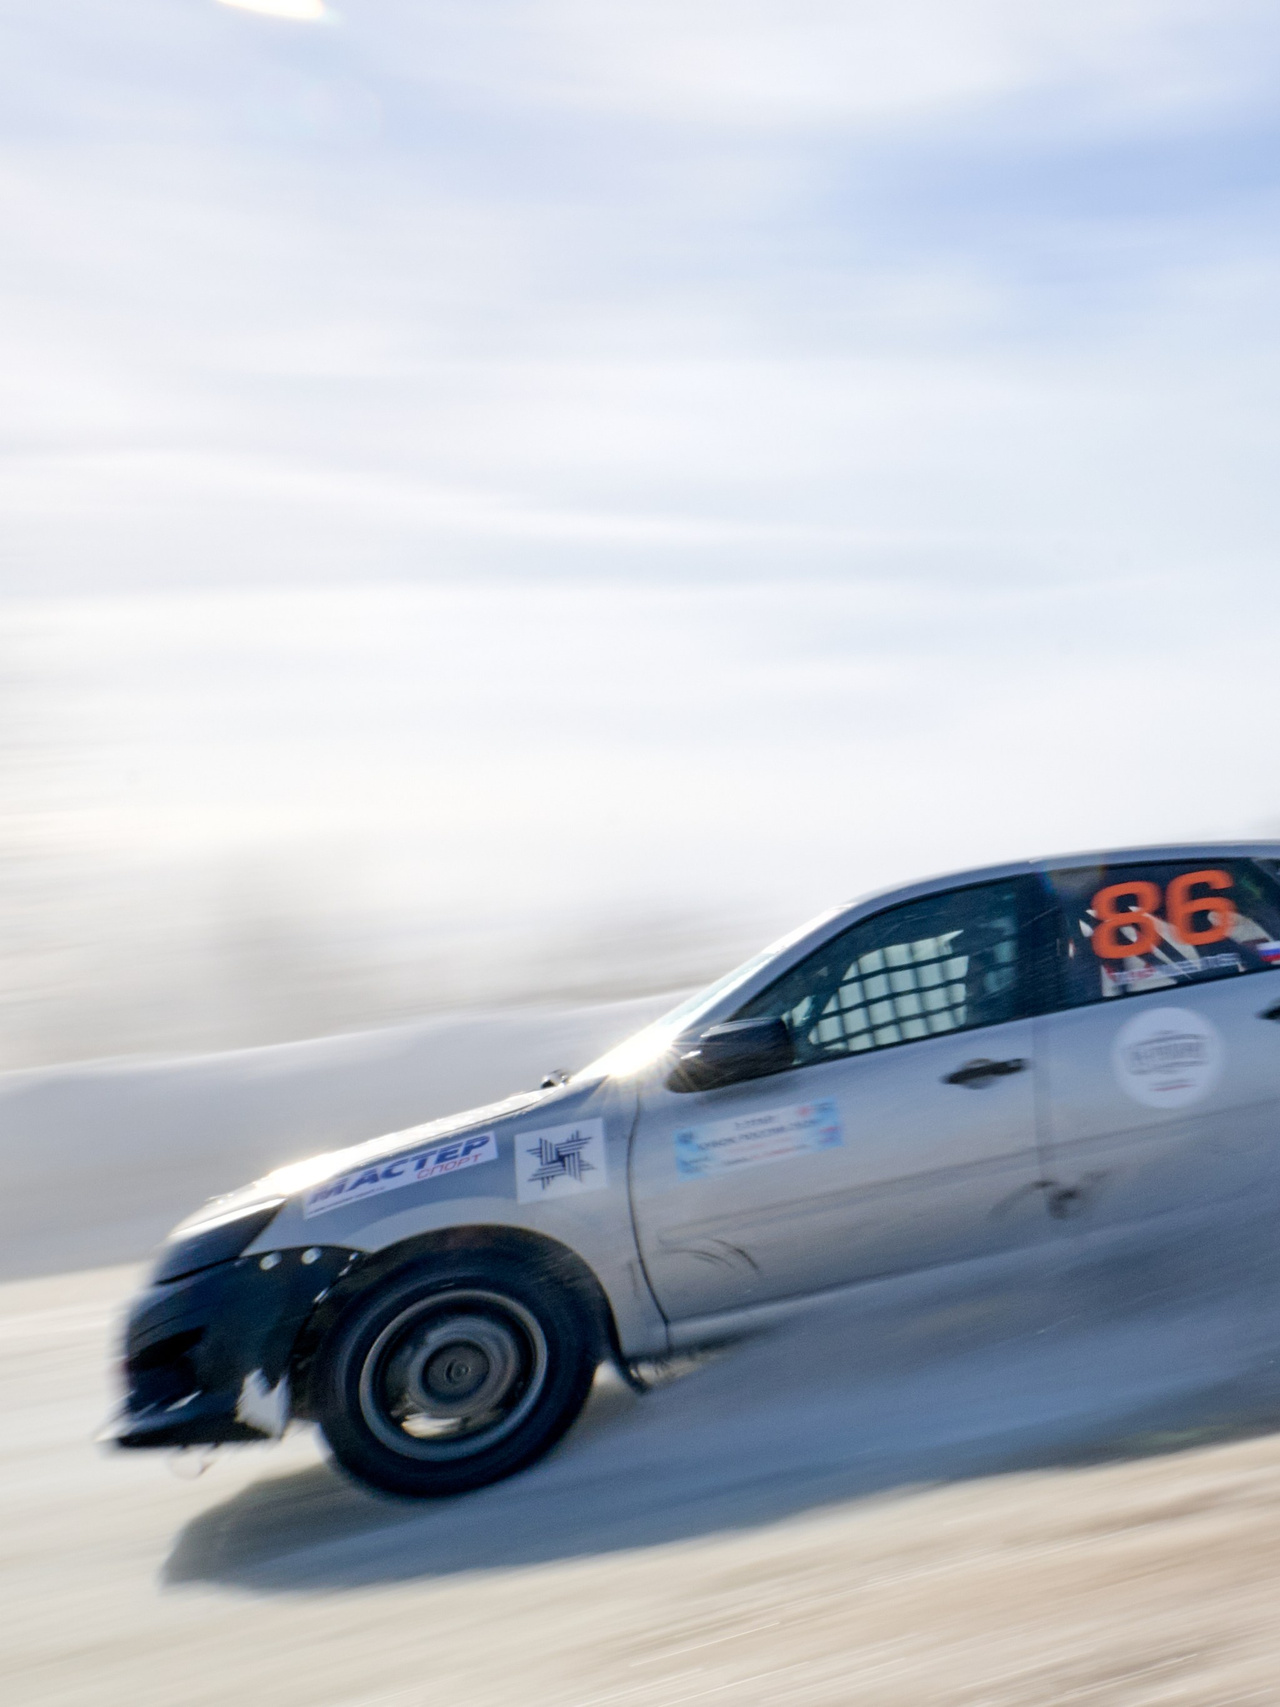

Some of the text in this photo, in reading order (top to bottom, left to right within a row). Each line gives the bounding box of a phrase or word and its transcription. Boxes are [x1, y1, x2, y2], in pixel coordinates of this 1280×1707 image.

[1091, 869, 1237, 959] 86
[306, 1135, 491, 1206] МАСТЕР
[416, 1152, 483, 1181] СПОРТ
